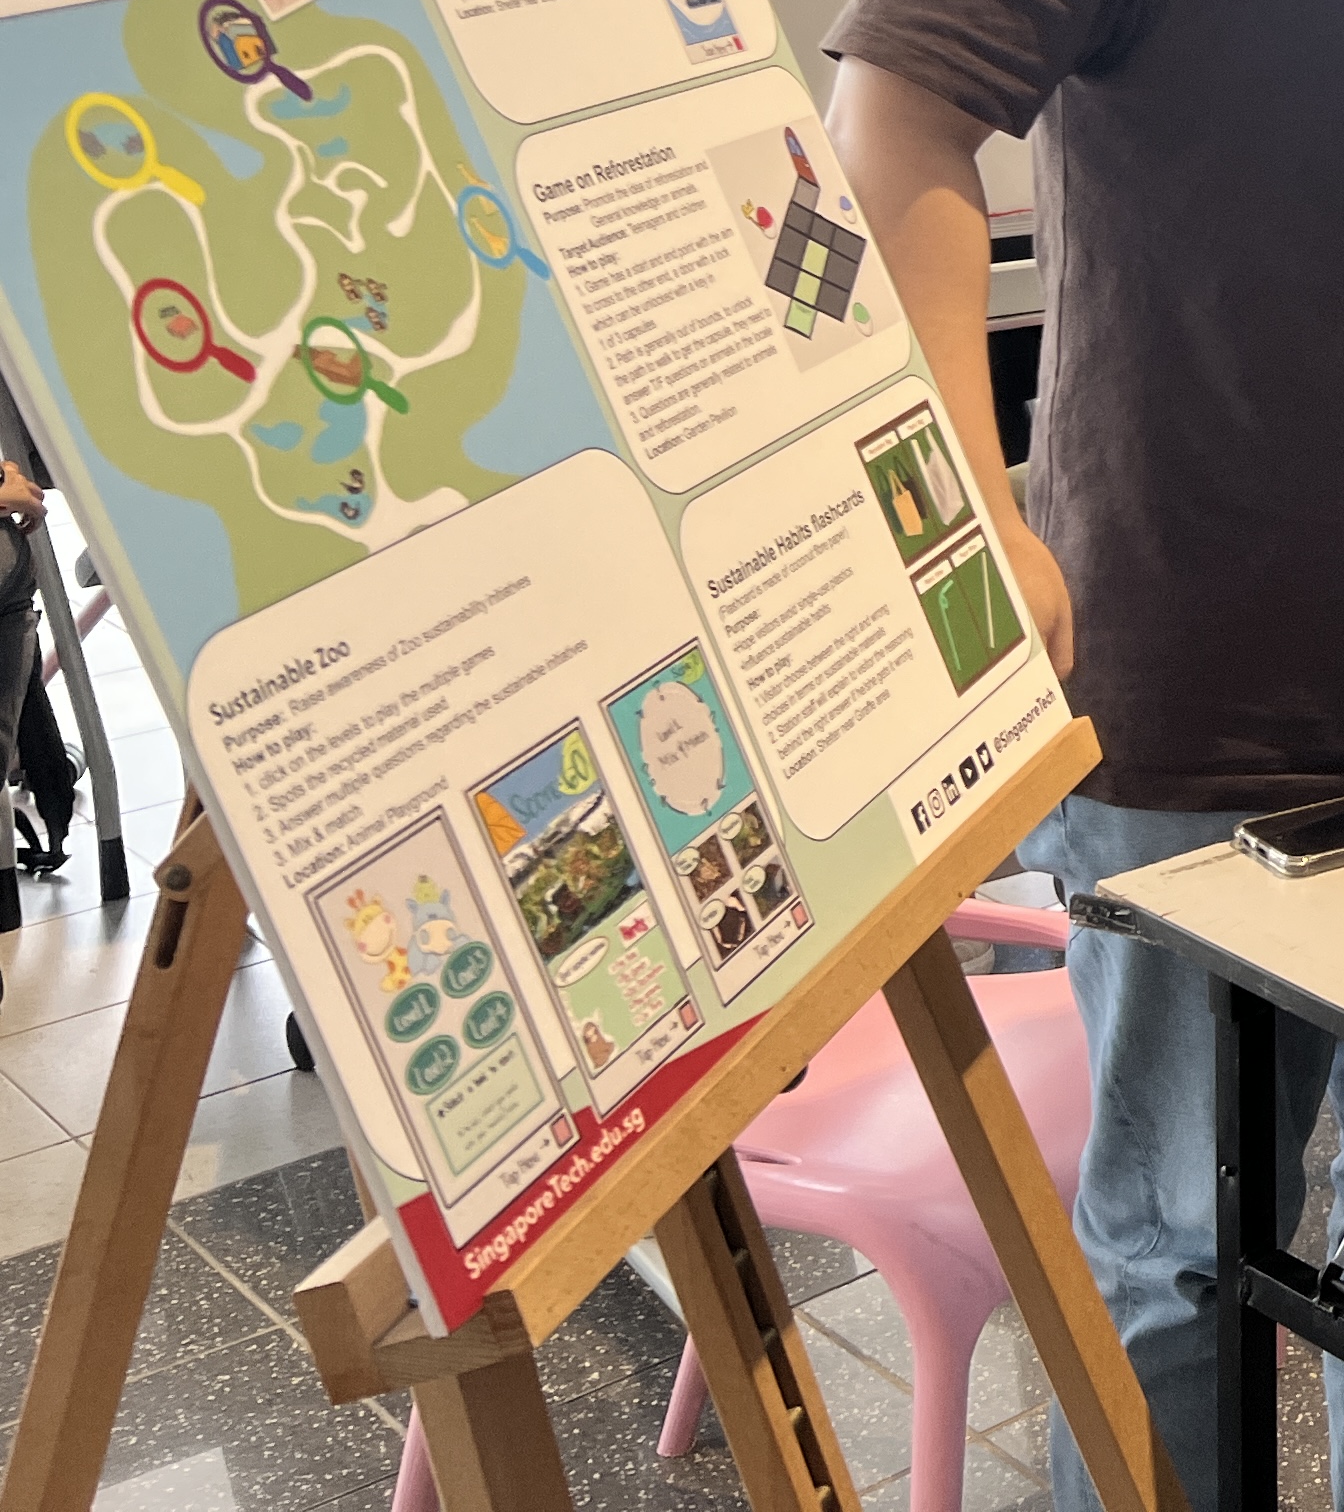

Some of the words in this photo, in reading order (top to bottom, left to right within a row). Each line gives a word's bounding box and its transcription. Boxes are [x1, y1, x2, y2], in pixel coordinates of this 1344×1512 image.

[531, 175, 576, 202] Game
[573, 171, 595, 188] on
[591, 143, 677, 182] Reforestation
[705, 543, 779, 600] Sustainable
[773, 520, 814, 555] Habits
[808, 487, 866, 533] flashcards
[206, 653, 318, 725] Sustainable
[313, 635, 352, 669] Zoo
[471, 695, 492, 716] the
[231, 747, 267, 776] How
[264, 738, 282, 757] to
[304, 740, 328, 763] the
[397, 686, 420, 708] the
[303, 767, 328, 790] the
[464, 1108, 646, 1279] SingaporeTech.edu.sg
